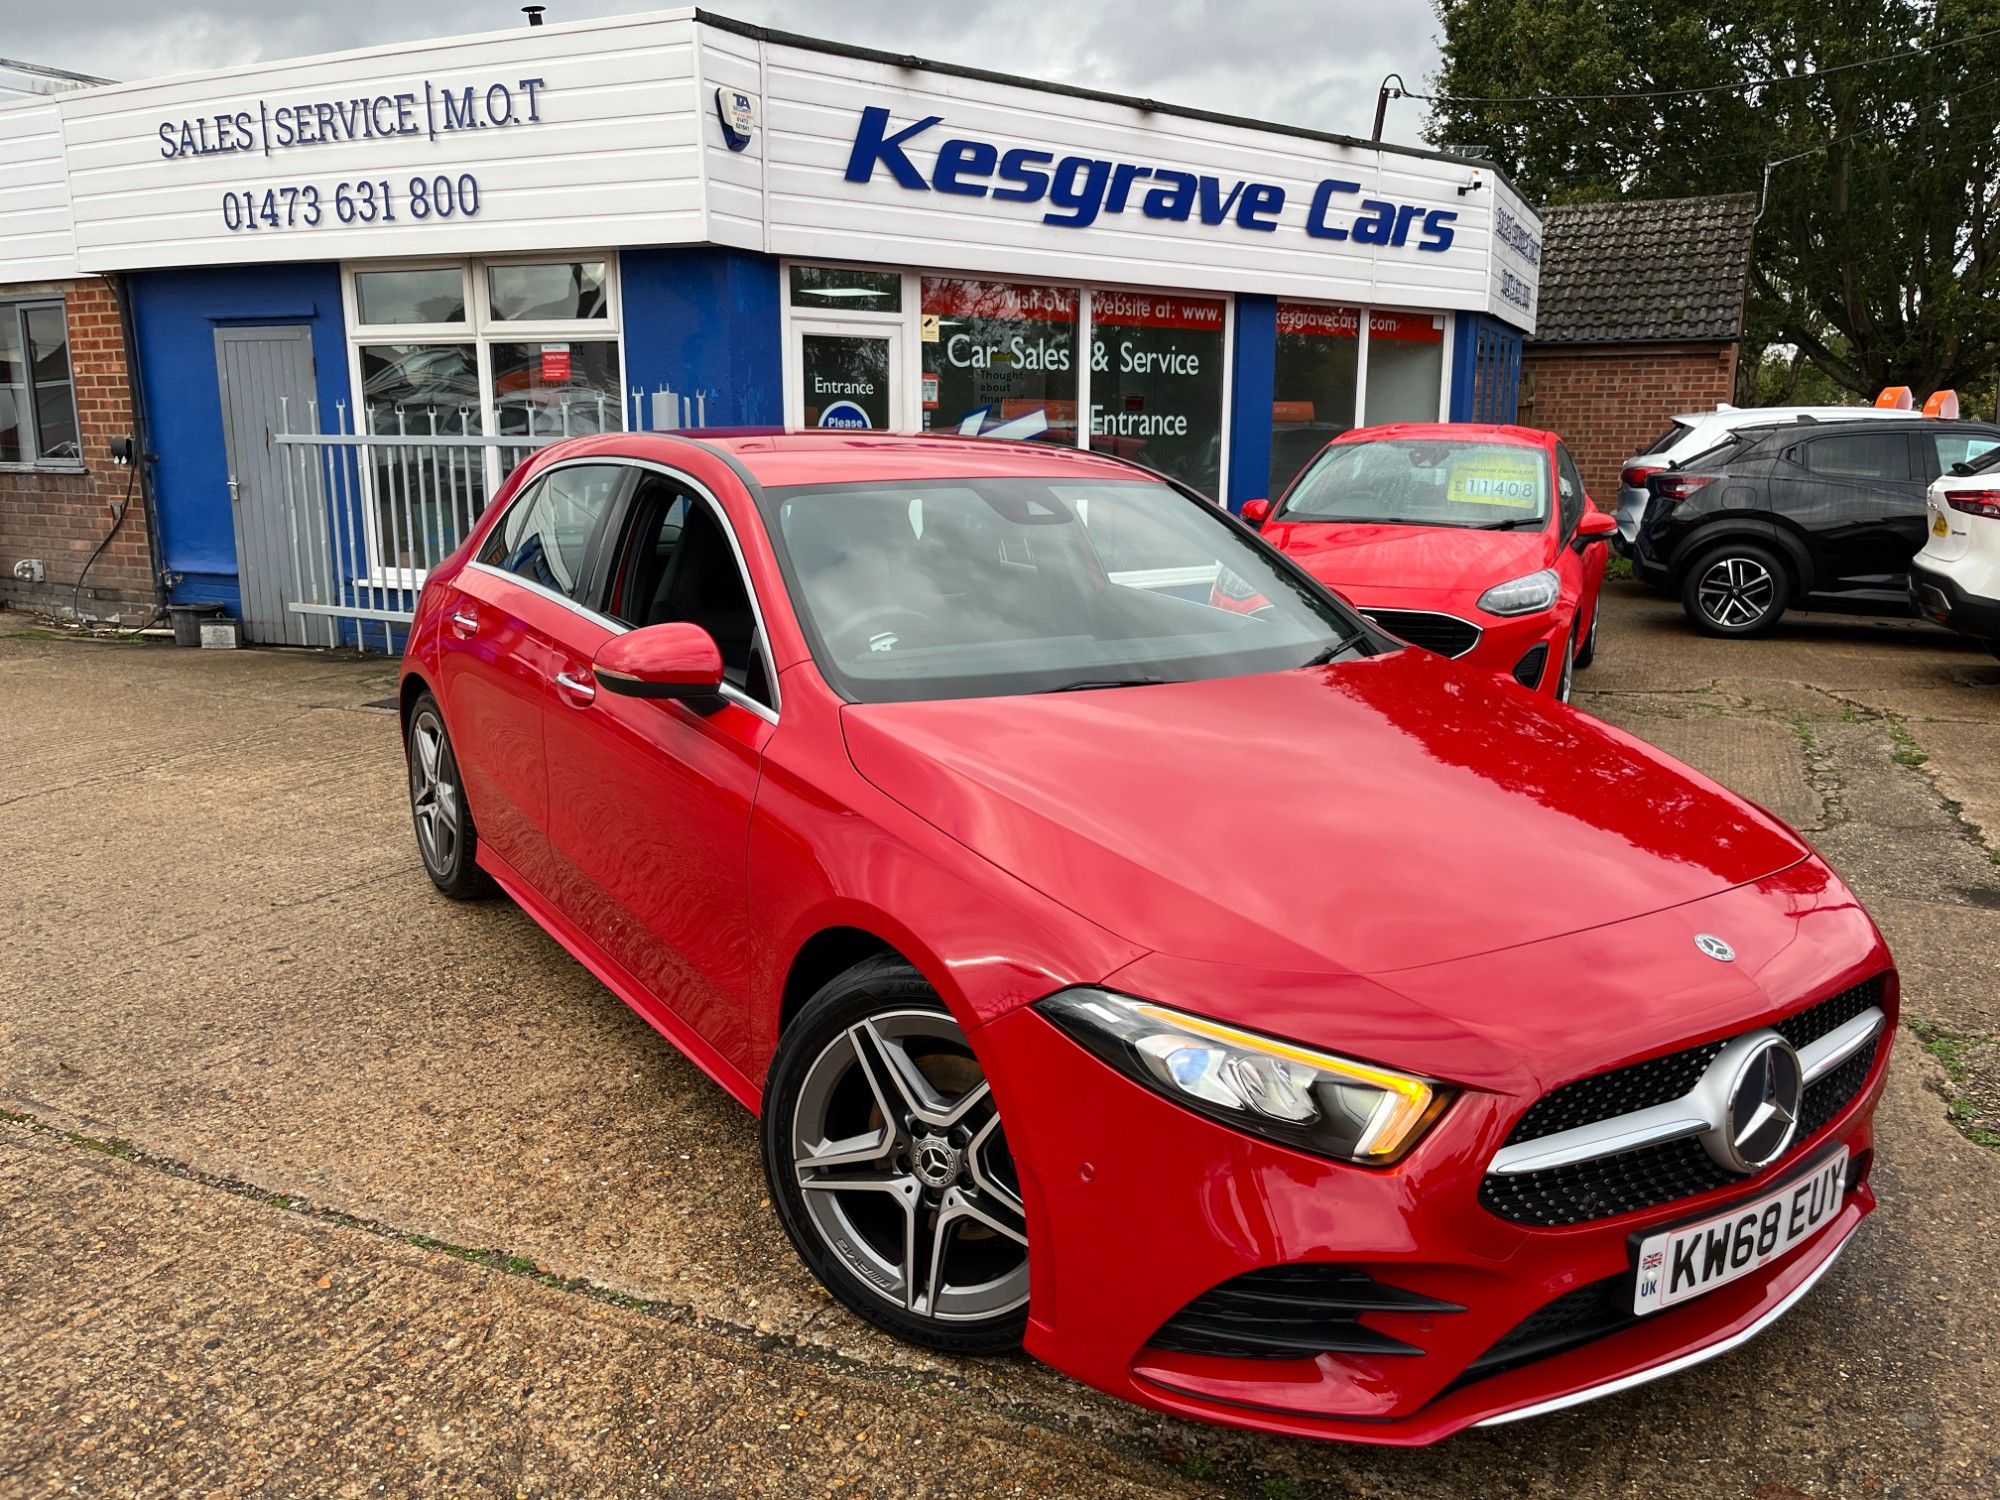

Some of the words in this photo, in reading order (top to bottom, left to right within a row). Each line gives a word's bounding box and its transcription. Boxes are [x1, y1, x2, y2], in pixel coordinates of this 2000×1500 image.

[159, 112, 254, 159] SALES
[275, 93, 419, 147] SERVICE
[441, 78, 544, 130] M.O.T
[844, 106, 1286, 231] Kesgrave
[1307, 179, 1458, 252] Cars
[222, 185, 322, 231] 01473
[335, 180, 396, 223] 631
[409, 173, 480, 219] 800
[1005, 287, 1040, 310] Visit
[1044, 296, 1071, 312] our
[1091, 298, 1151, 317] website
[1155, 302, 1175, 319] at:
[1182, 306, 1222, 322] www.
[948, 333, 999, 368] Car
[1011, 336, 1070, 371] Sales
[1091, 341, 1109, 372] &
[1120, 341, 1199, 375] Service
[814, 376, 874, 395] Entrance
[980, 370, 1024, 382] Thought
[980, 383, 1011, 391] about
[980, 394, 1024, 404] finance?
[828, 417, 863, 428] Please
[1090, 404, 1188, 436] Entrance
[1669, 1201, 1782, 1294] KW68
[1787, 1157, 1845, 1241] EUY
[1641, 1280, 1657, 1297] UK
